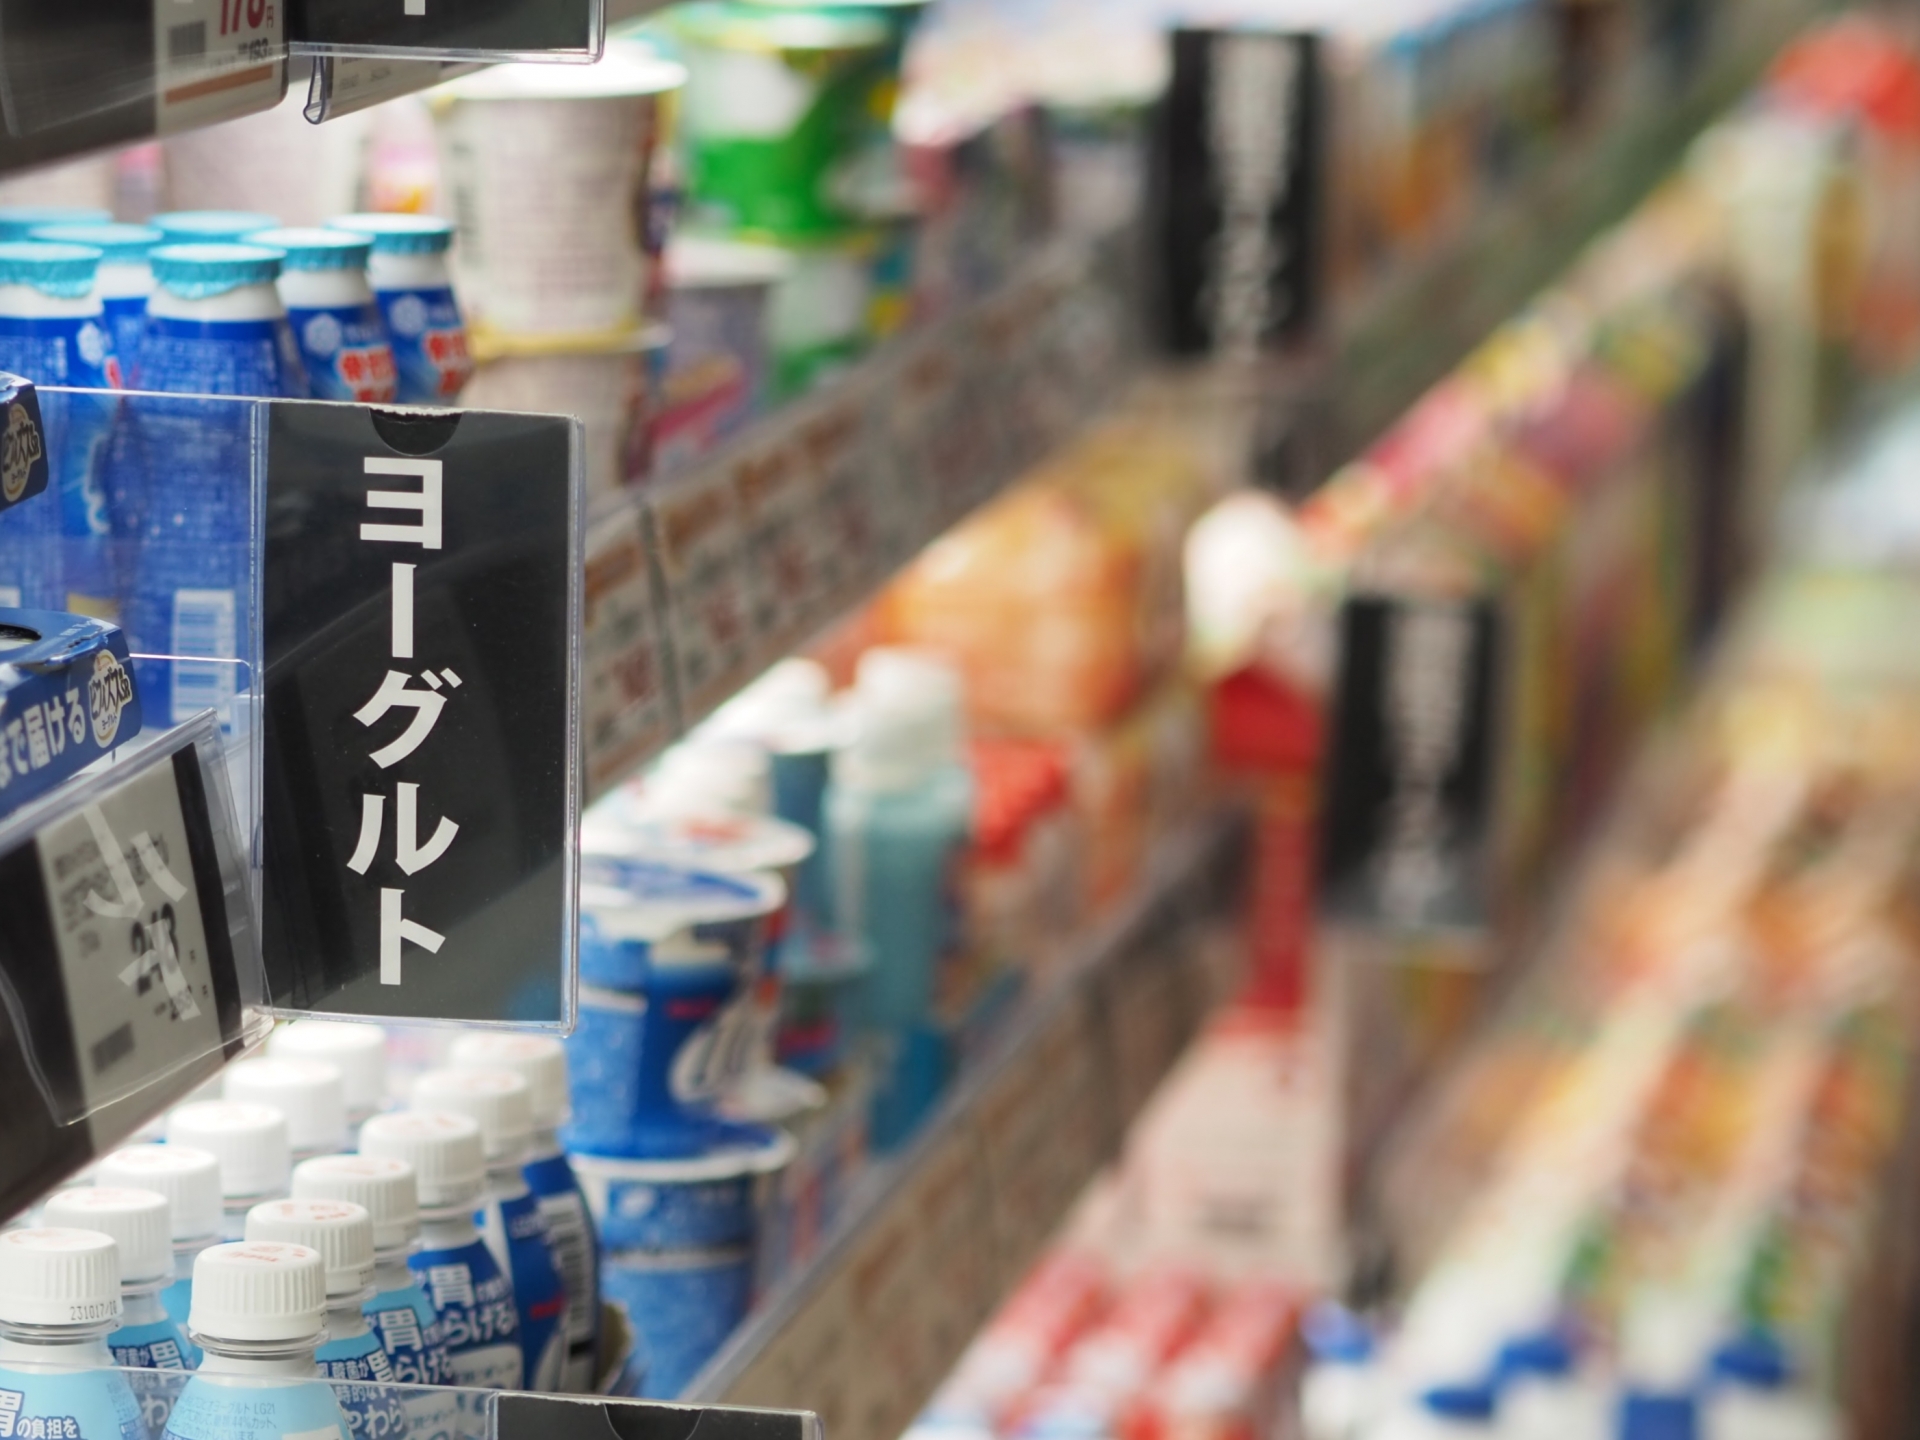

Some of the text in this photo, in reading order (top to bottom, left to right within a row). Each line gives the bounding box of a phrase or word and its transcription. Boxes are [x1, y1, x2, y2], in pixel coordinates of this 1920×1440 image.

[347, 456, 462, 985] ヨーグルト
